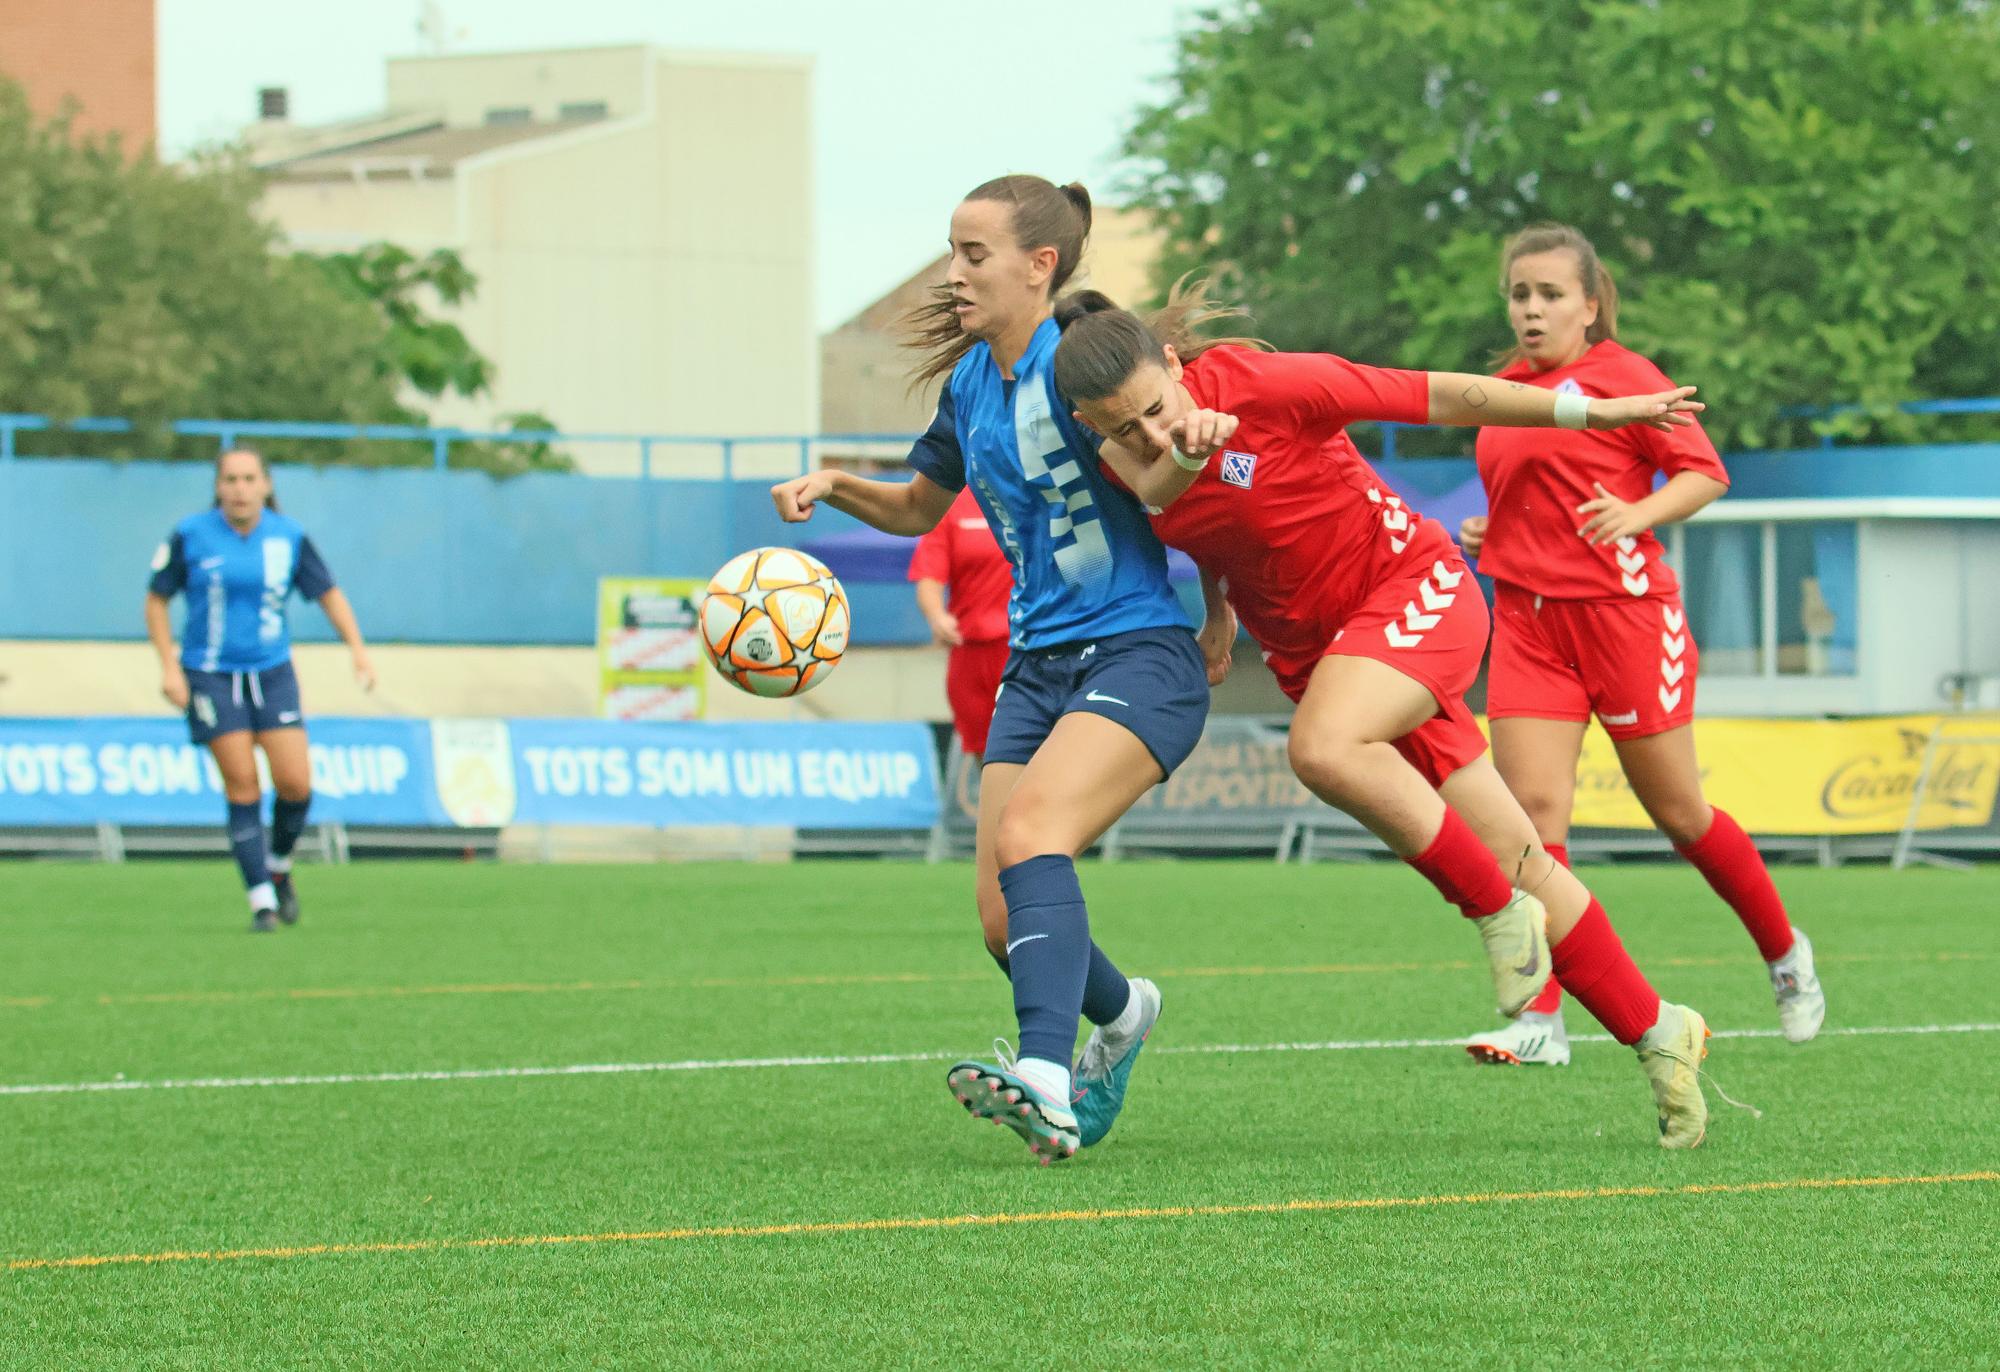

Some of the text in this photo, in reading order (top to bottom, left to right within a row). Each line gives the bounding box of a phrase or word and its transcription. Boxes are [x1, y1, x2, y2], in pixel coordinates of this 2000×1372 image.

[0, 743, 96, 795] OTS
[98, 743, 202, 795] SOM
[308, 743, 408, 799] QUIP
[523, 746, 921, 802] TOTS SOM UN EQUIP
